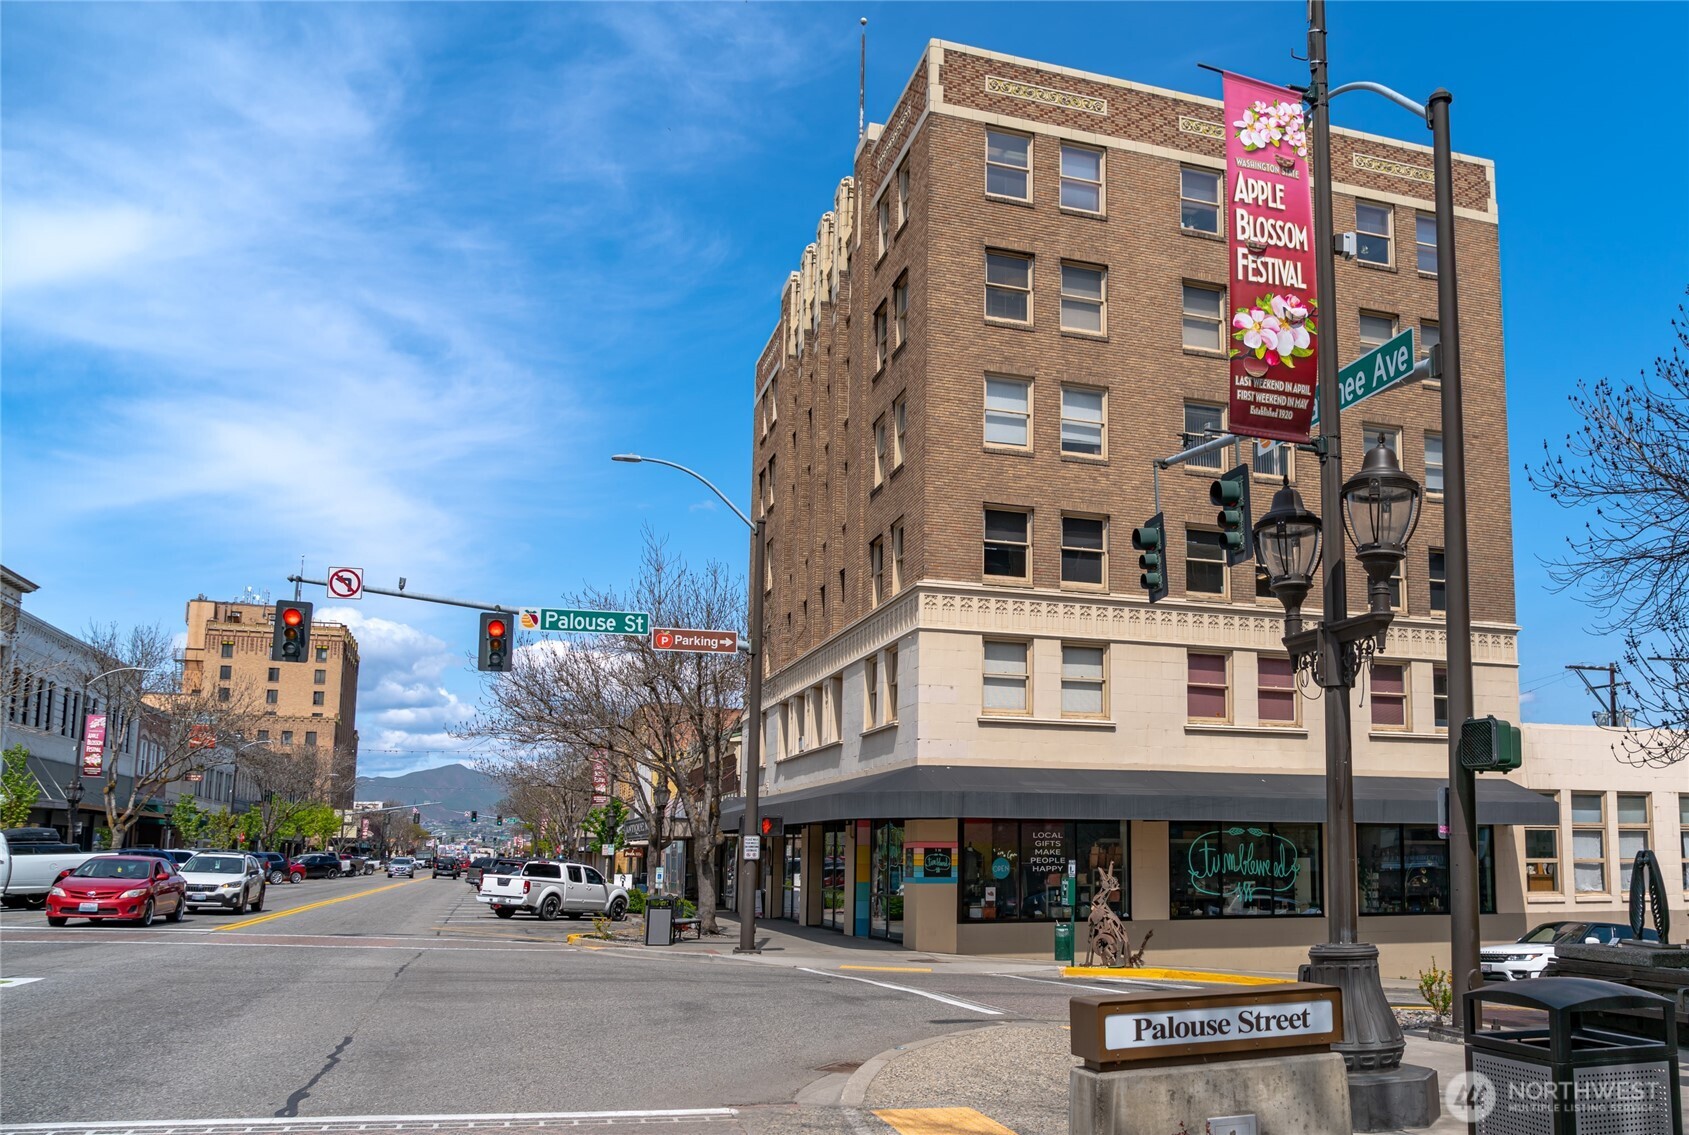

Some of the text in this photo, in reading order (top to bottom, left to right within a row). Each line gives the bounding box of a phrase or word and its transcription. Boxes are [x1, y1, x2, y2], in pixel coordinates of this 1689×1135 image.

[1236, 157, 1300, 179] WASHINGTON STATE
[1234, 171, 1286, 210] APPLE
[1236, 208, 1309, 251] BLOSSOM
[1237, 247, 1308, 289] FESTIVAL
[1372, 345, 1409, 388] Ave
[1234, 375, 1311, 396] LAST WEEKEND IN APRIL
[1236, 389, 1255, 402] FIRST
[1255, 392, 1287, 407] WEEKEND
[1287, 396, 1295, 408] IN
[1295, 397, 1310, 410] MAY
[1249, 405, 1293, 420] Established 1920
[545, 612, 644, 633] Palouse St
[661, 635, 719, 648] P Parking
[993, 865, 1010, 873] OPEN
[1195, 840, 1291, 878] tumbleweed
[1132, 1007, 1311, 1042] Palouse Street
